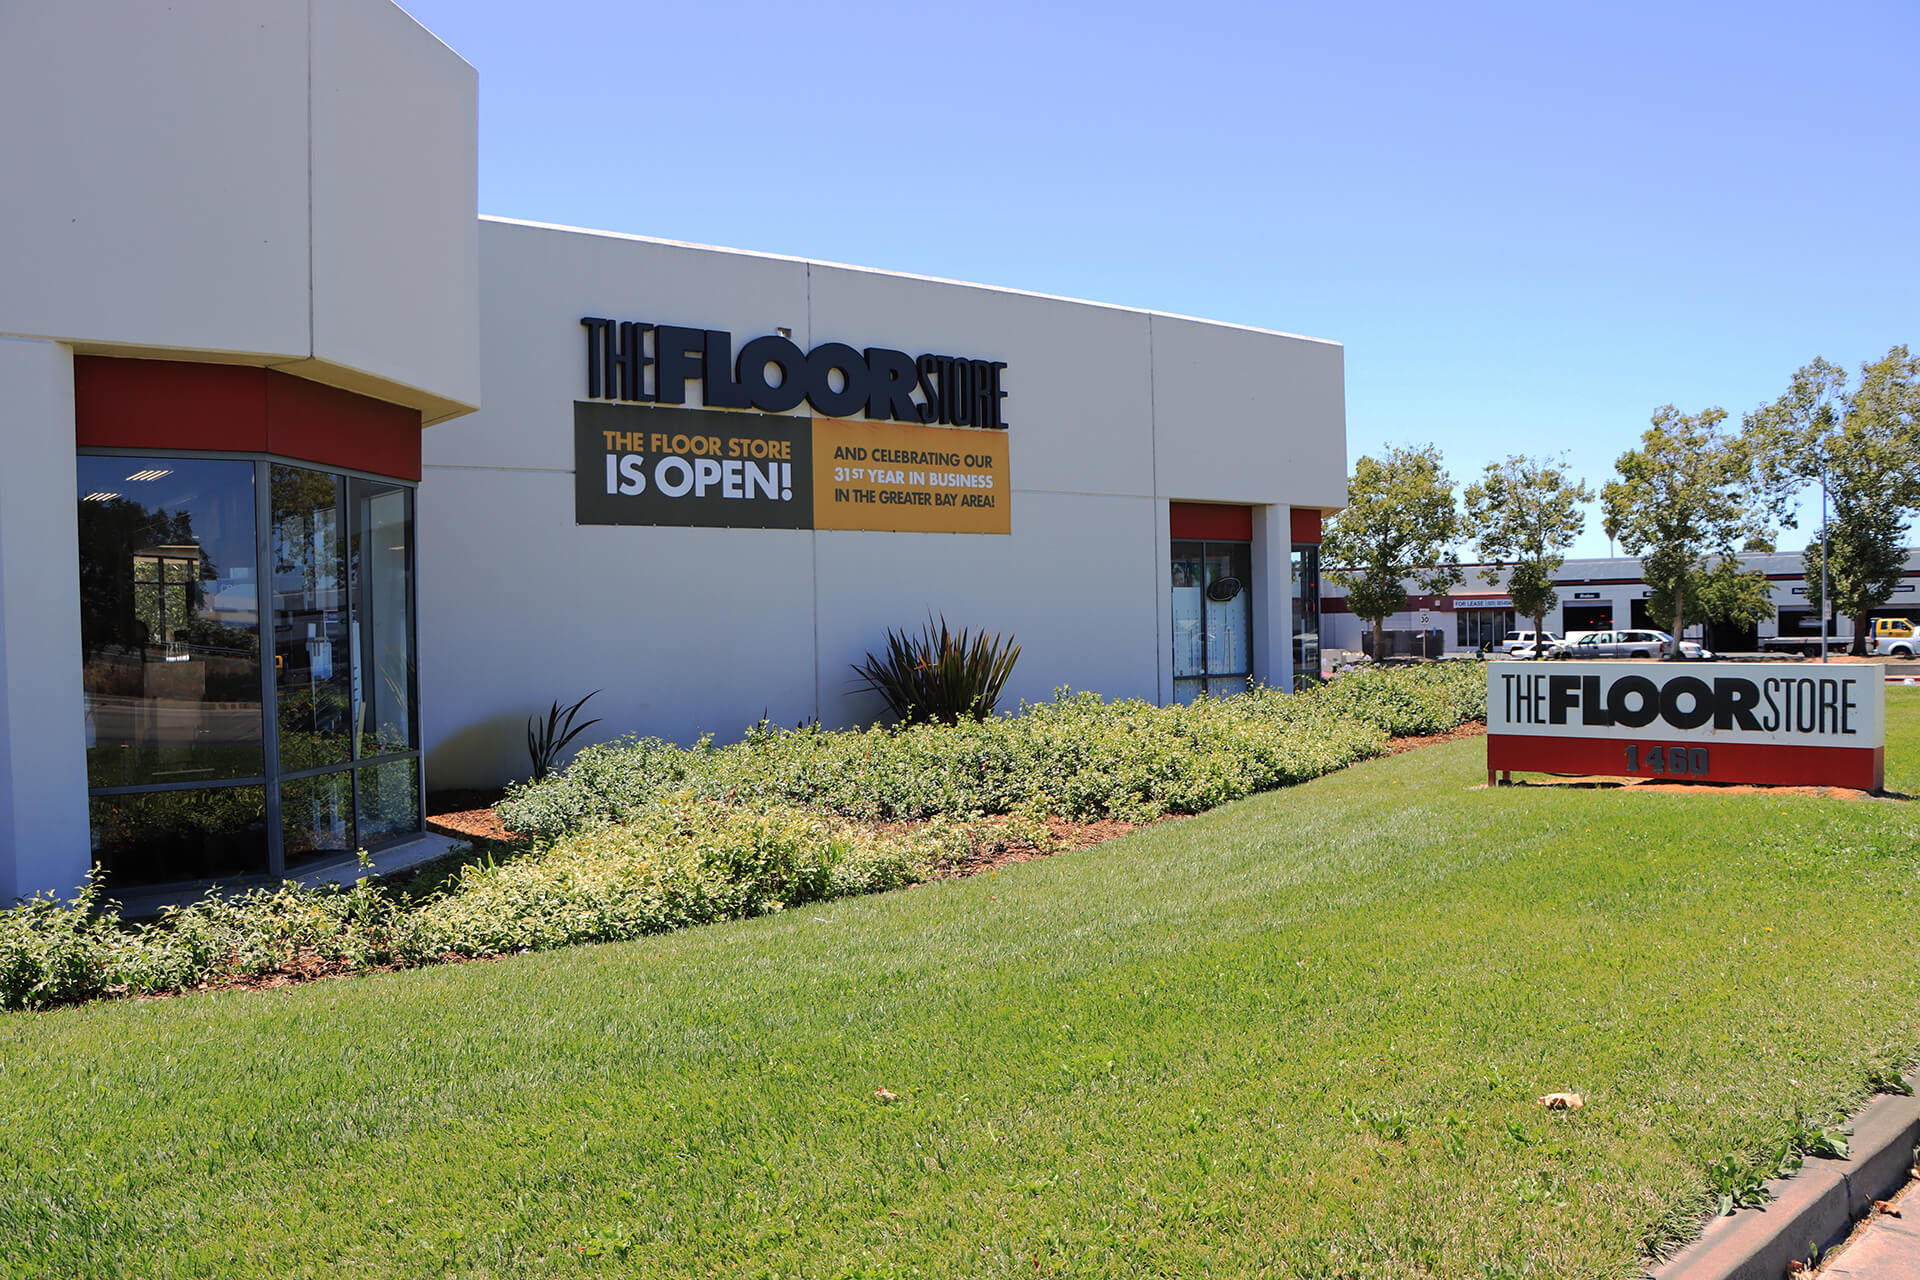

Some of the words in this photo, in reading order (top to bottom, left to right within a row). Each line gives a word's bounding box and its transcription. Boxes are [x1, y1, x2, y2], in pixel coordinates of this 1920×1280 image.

[580, 317, 655, 402] THE
[655, 325, 926, 423] FLOOR
[916, 353, 1009, 430] STORE
[603, 430, 645, 452] THE
[651, 433, 723, 456] FLOOR
[728, 437, 792, 460] STORE
[833, 446, 868, 461] AND
[871, 448, 961, 467] CELEBRATING
[964, 453, 993, 469] OUR
[606, 453, 647, 497] IS
[654, 455, 793, 502] OPEN!
[834, 467, 865, 482] 31ST
[867, 469, 905, 485] YEAR
[909, 471, 925, 486] IN
[929, 472, 994, 489] BUSINESS
[834, 488, 850, 502] IN
[852, 489, 876, 504] THE
[879, 490, 932, 506] GREATER
[935, 493, 958, 507] BAY
[961, 494, 996, 508] AREA!
[1501, 674, 1546, 725] THE
[1549, 674, 1764, 731] FLOOR
[1763, 677, 1857, 735] STORE
[1625, 745, 1709, 777] 1460
